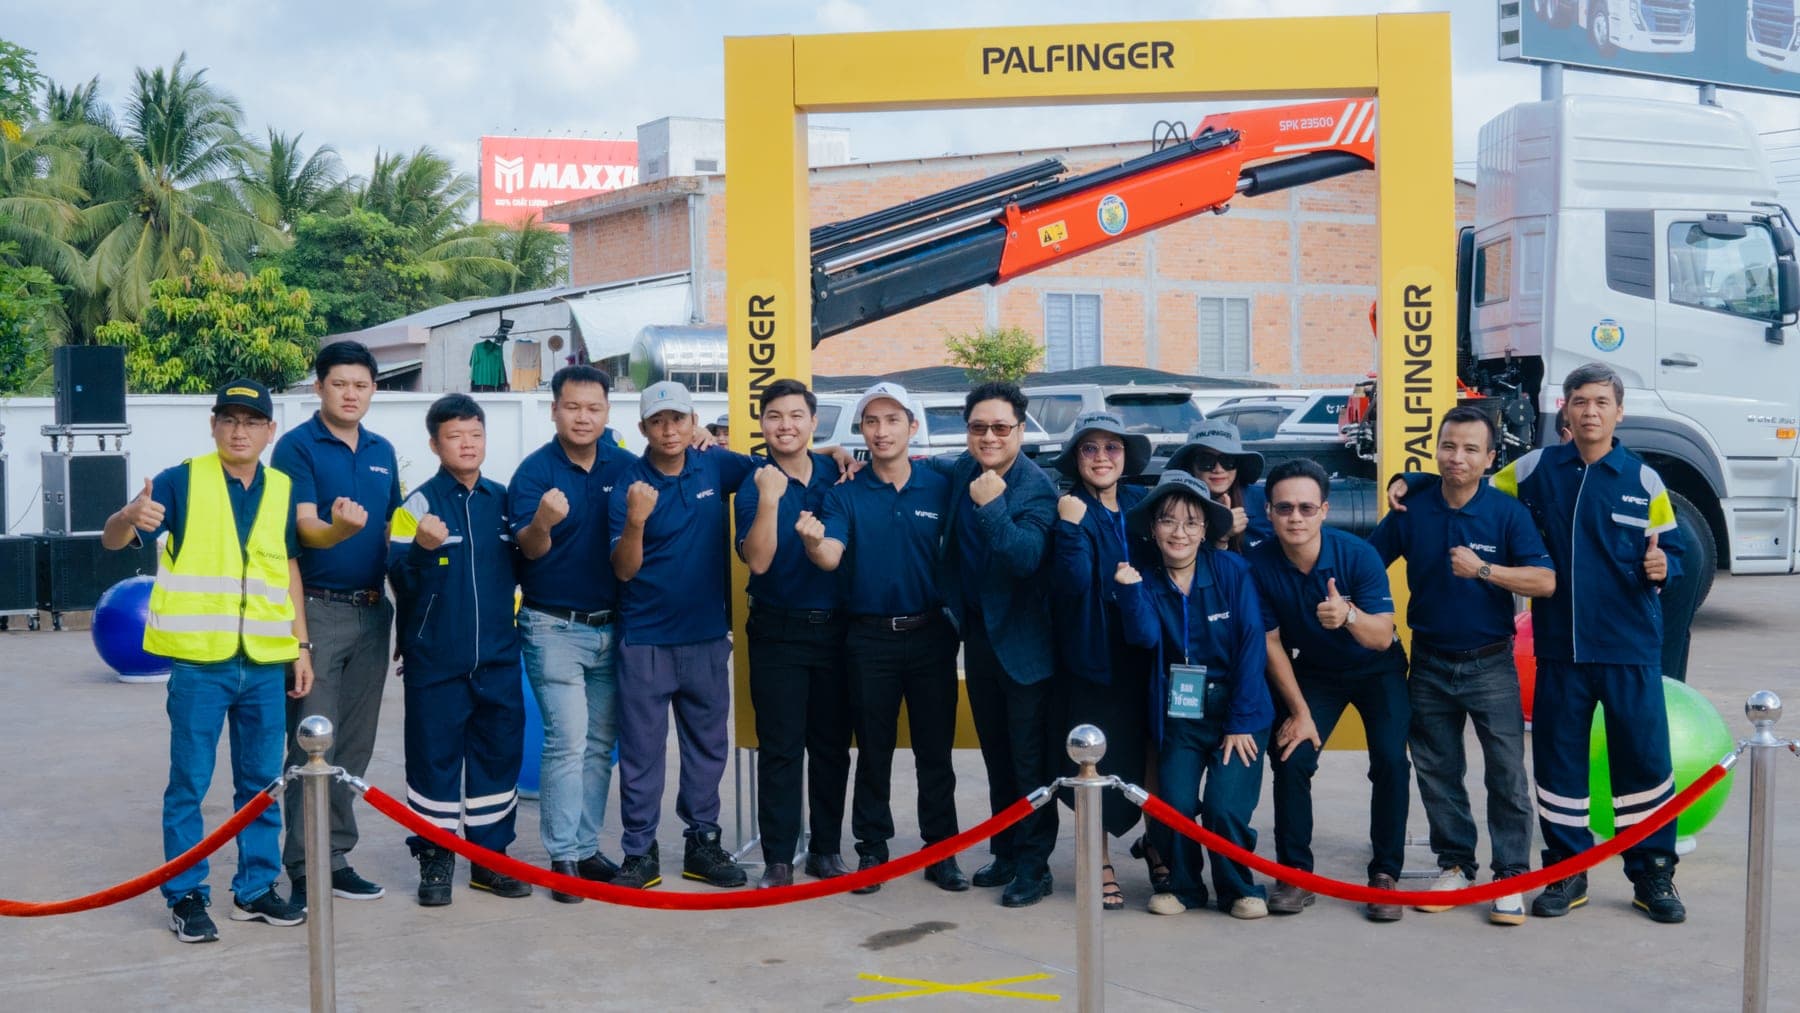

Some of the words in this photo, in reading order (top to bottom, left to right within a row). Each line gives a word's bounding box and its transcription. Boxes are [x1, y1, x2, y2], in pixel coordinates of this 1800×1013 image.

[983, 41, 1174, 75] PALFINGER
[1279, 120, 1299, 131] SPK
[1301, 116, 1334, 129] 23500
[1621, 494, 1649, 505] VIPEC
[1469, 541, 1496, 553] VIPEC
